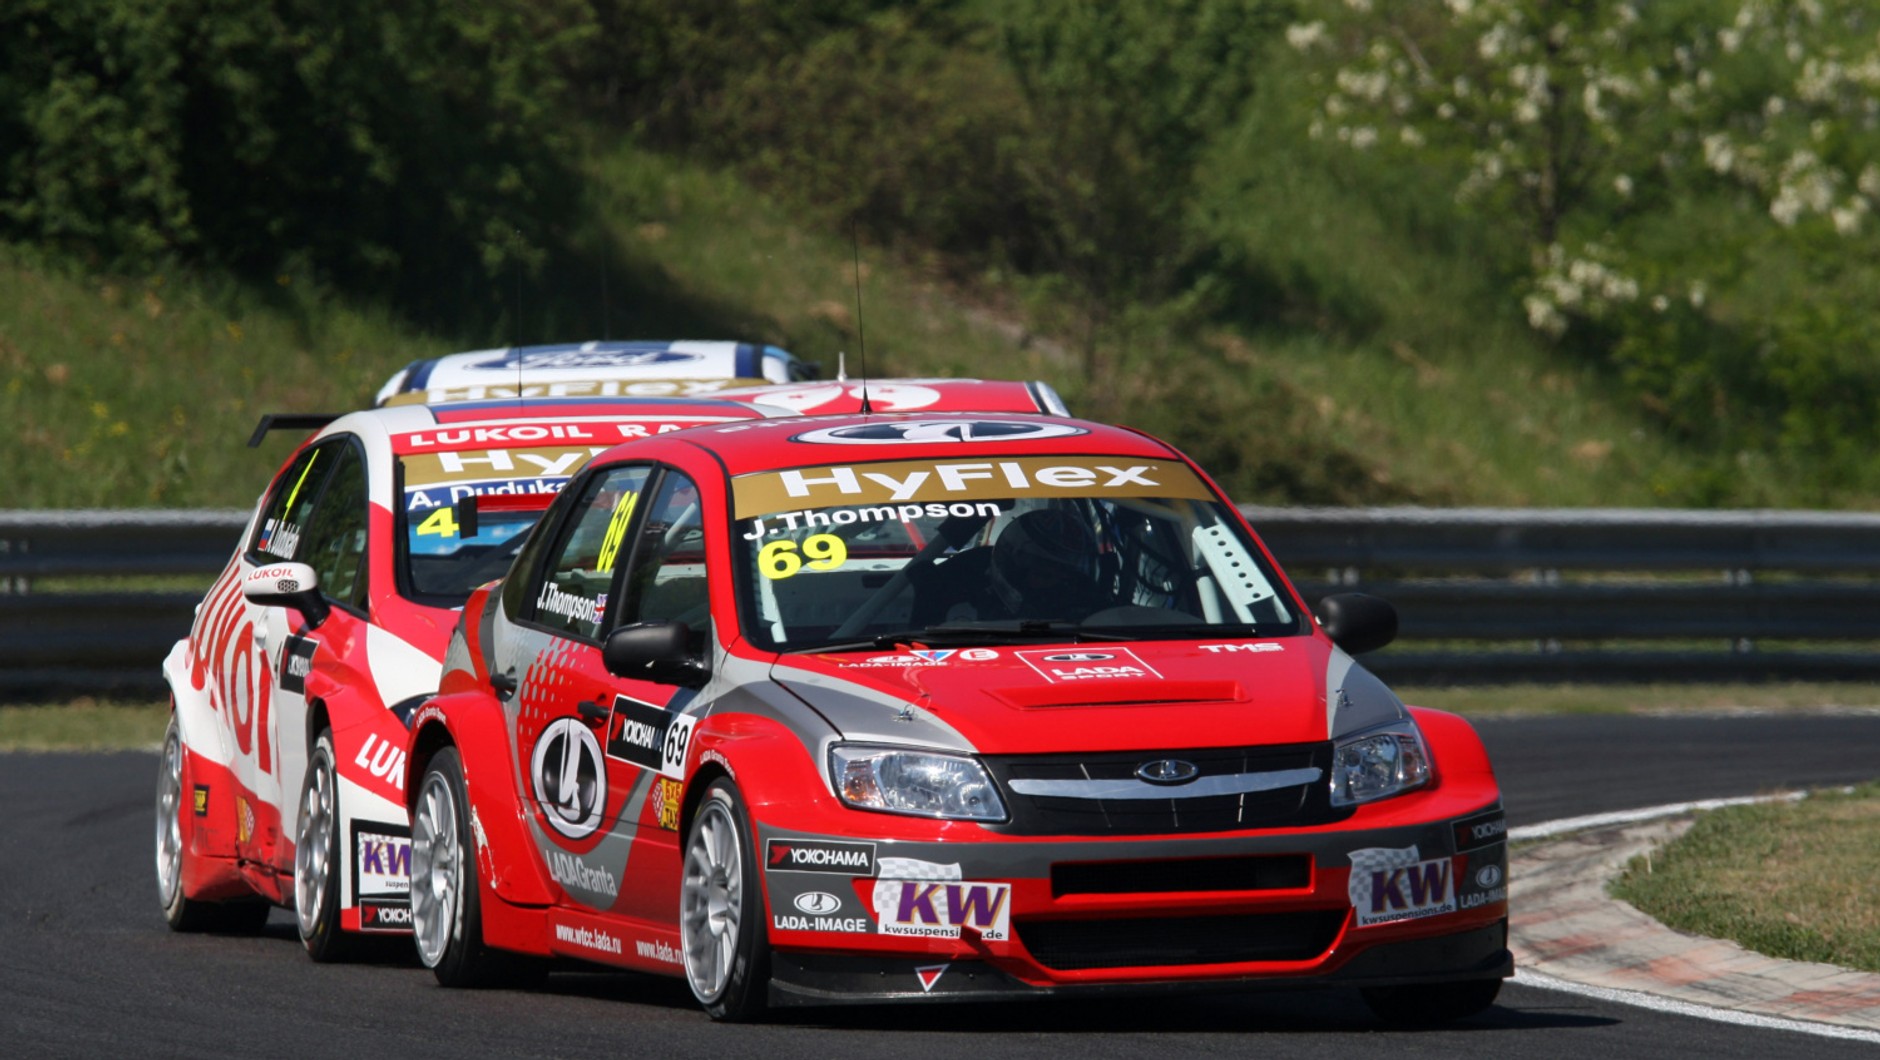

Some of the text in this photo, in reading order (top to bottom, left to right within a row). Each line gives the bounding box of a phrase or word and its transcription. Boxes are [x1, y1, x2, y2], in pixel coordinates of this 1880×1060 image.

[410, 425, 593, 447] LUKOIL
[778, 461, 1160, 500] HyFlex
[407, 490, 442, 512] A.
[416, 506, 460, 538] 4
[596, 490, 638, 574] 69
[743, 502, 1001, 541] J.Thompson
[757, 533, 848, 581] 69
[247, 568, 294, 581] LUKOIL
[536, 581, 596, 623] J.Thompson
[1198, 642, 1284, 653] TMS
[1051, 665, 1145, 677] LADA
[1060, 672, 1146, 681] SPORT
[665, 721, 690, 767] 69
[363, 840, 412, 877] KW
[790, 848, 869, 868] YOKOHAMA
[1371, 860, 1451, 914] KW
[896, 881, 1009, 928] KW
[1361, 903, 1453, 925] kwsuspensions.de
[555, 924, 622, 954] www.wtcc.lada.ru
[773, 915, 867, 933] LADA-IMAGE
[884, 924, 1003, 939] kwsuspensi.de
